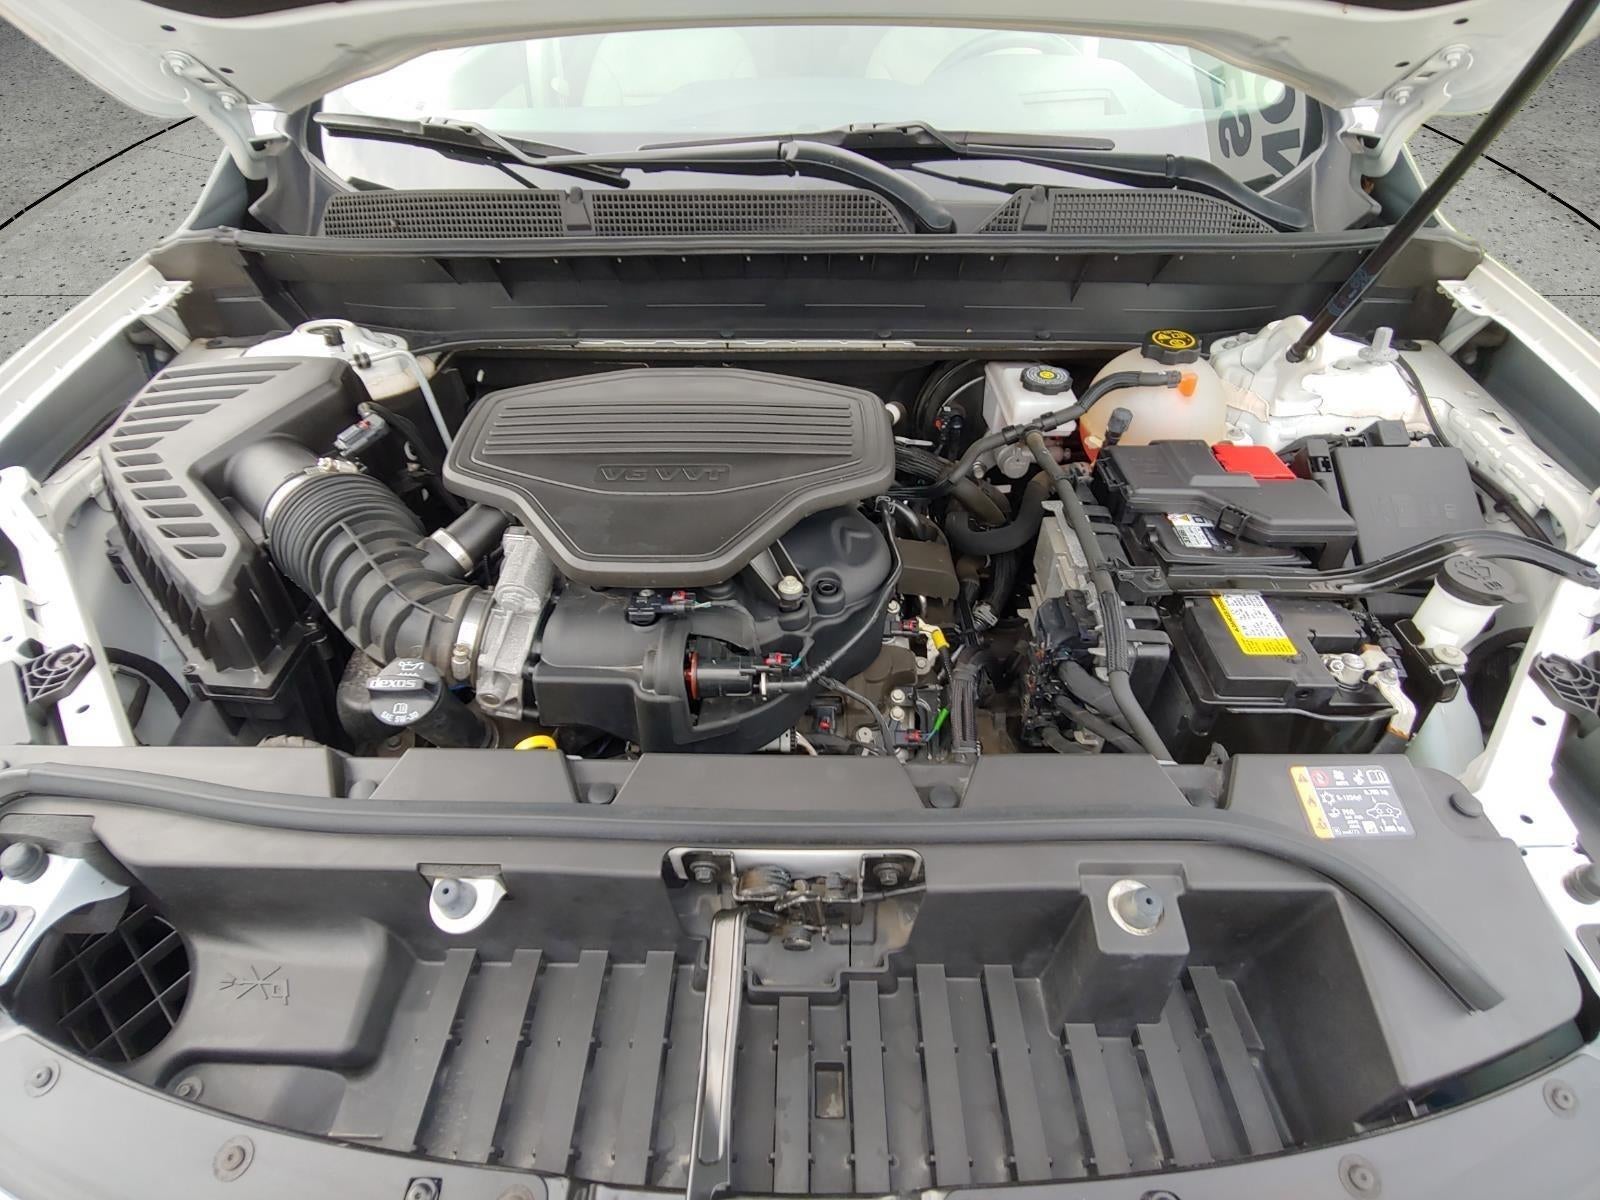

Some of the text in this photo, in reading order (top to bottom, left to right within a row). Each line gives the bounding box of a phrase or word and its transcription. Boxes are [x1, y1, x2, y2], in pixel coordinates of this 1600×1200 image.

[601, 466, 726, 481] V6 VVT
[369, 677, 416, 688] dexos
[381, 711, 394, 721] SAE
